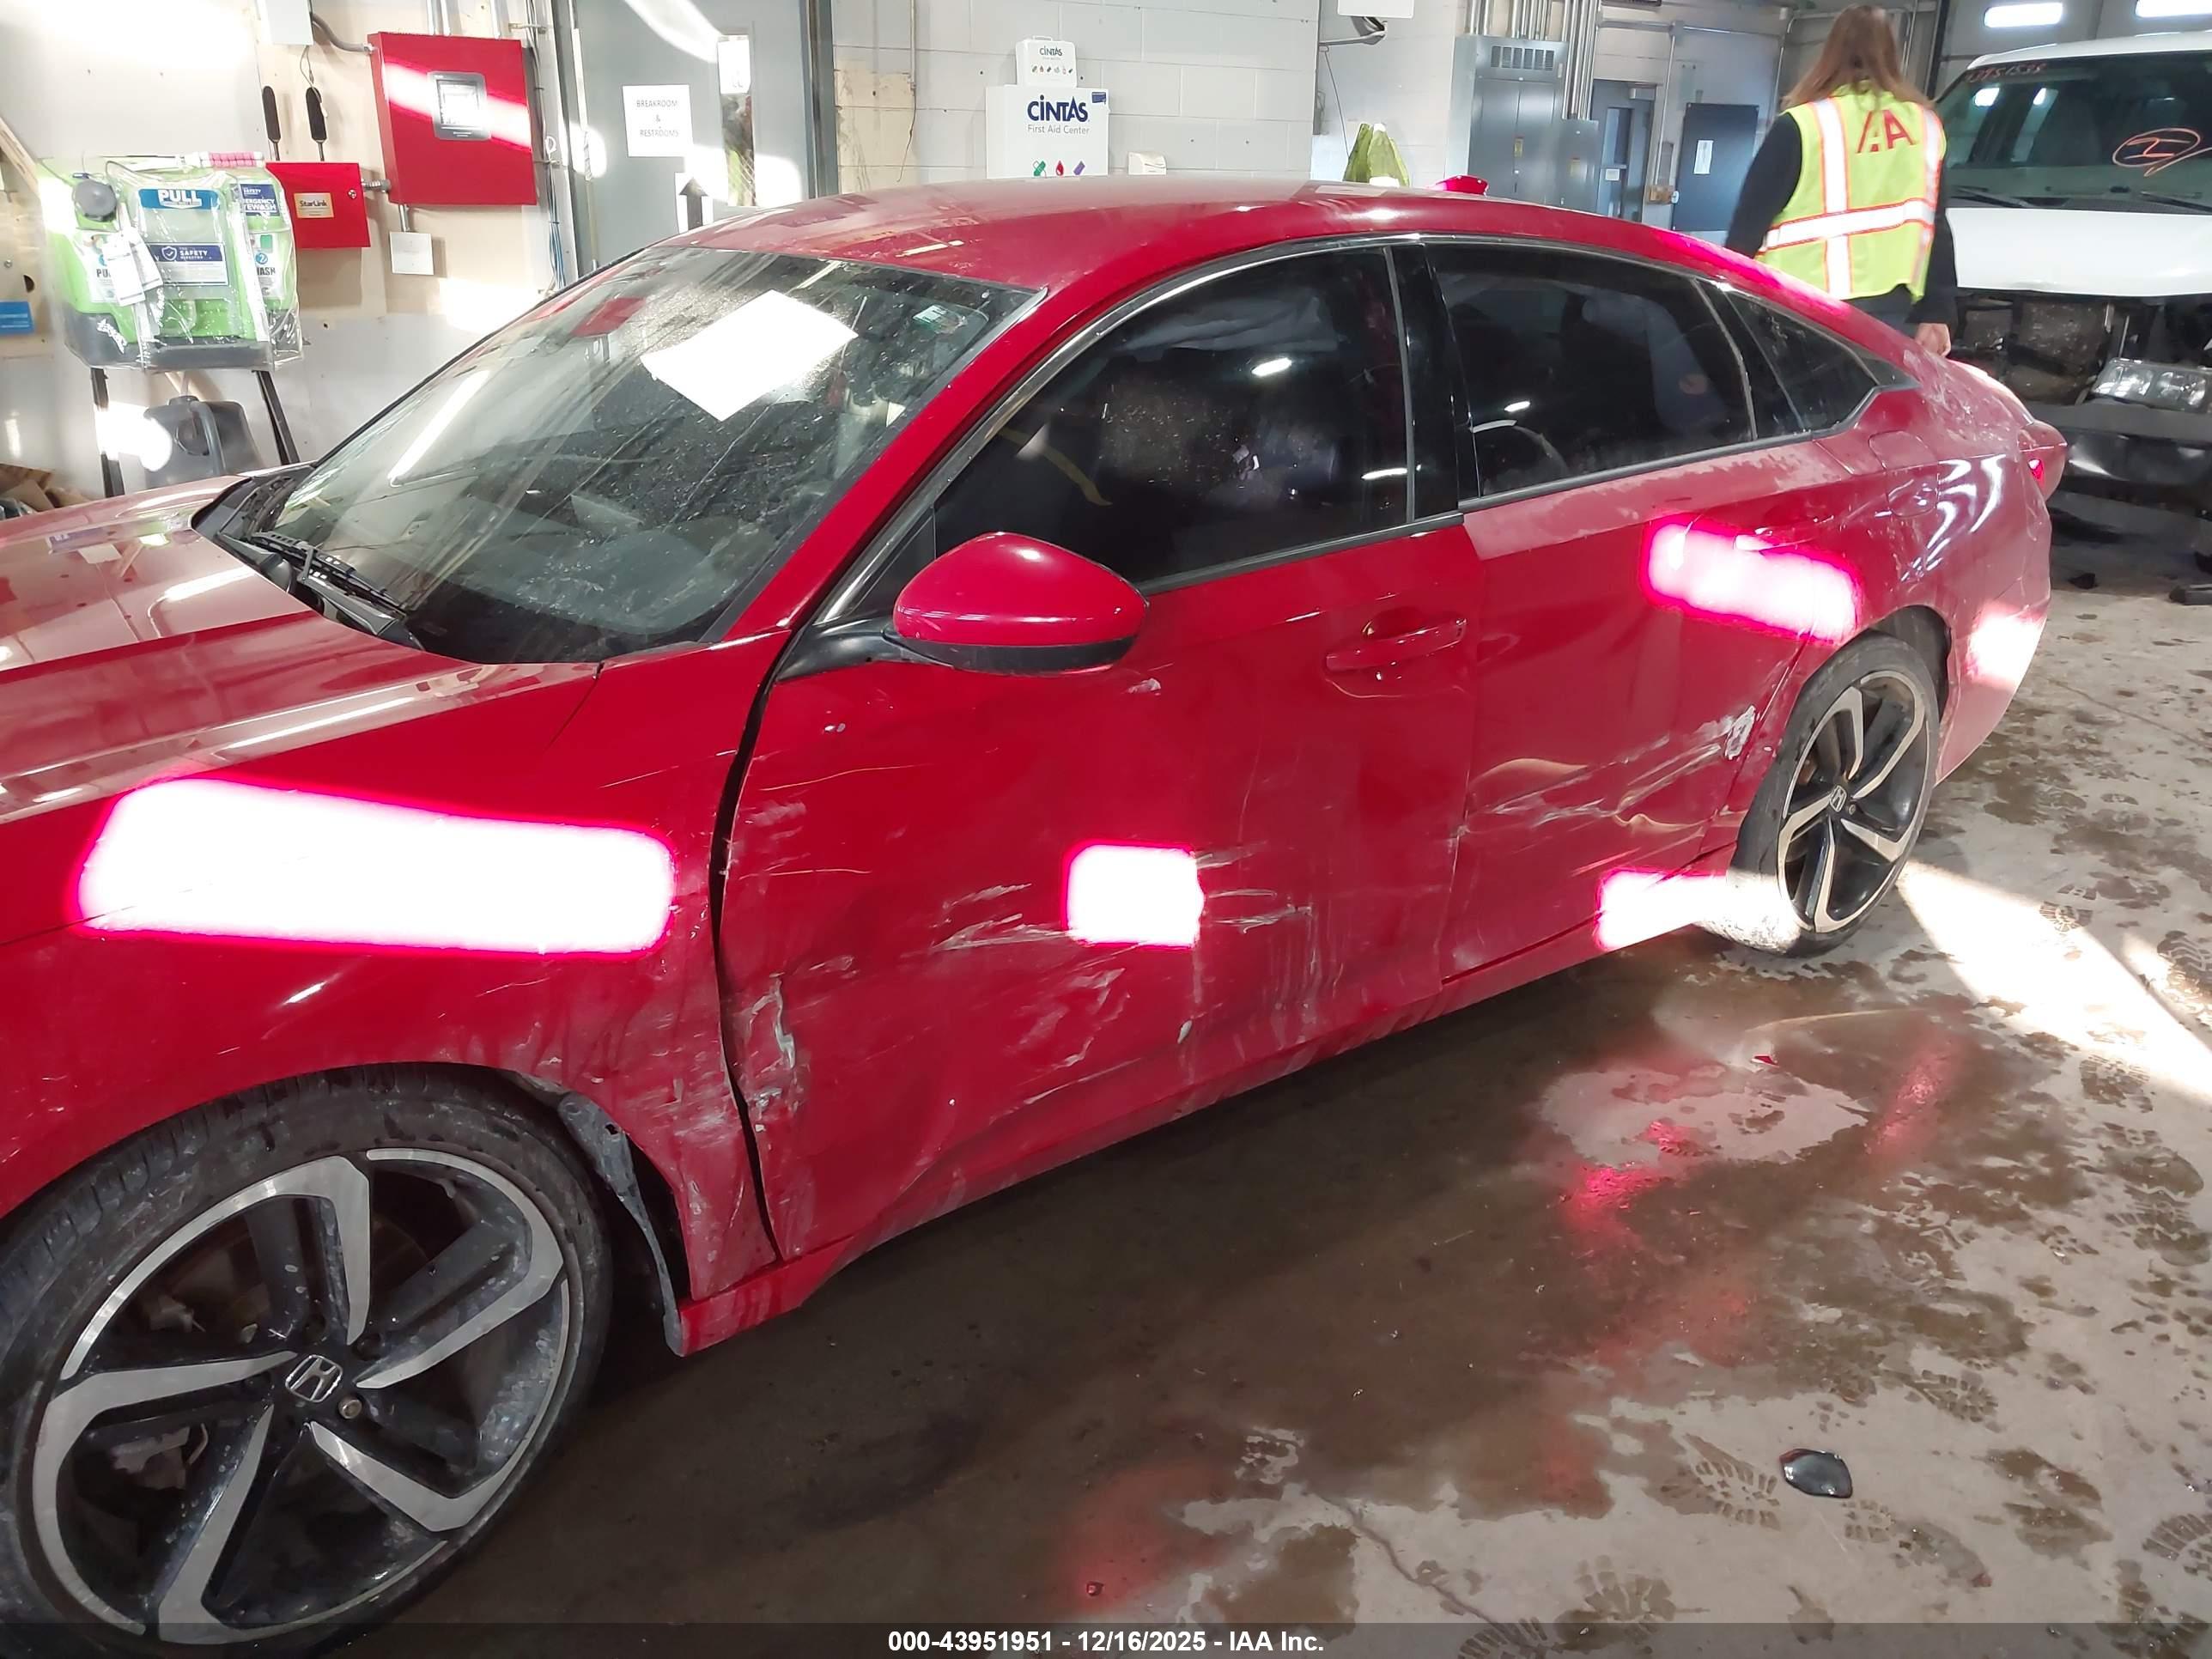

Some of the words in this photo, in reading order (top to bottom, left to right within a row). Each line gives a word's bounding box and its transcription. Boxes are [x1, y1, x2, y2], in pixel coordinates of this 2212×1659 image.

[1039, 46, 1063, 56] CINTAS
[636, 99, 678, 108] BREAKROOM
[1027, 94, 1089, 122] CINTAS
[1028, 124, 1045, 133] First
[1048, 124, 1061, 134] Aid
[1064, 125, 1091, 135] Center
[158, 189, 202, 203] PULL
[96, 269, 112, 278] PU
